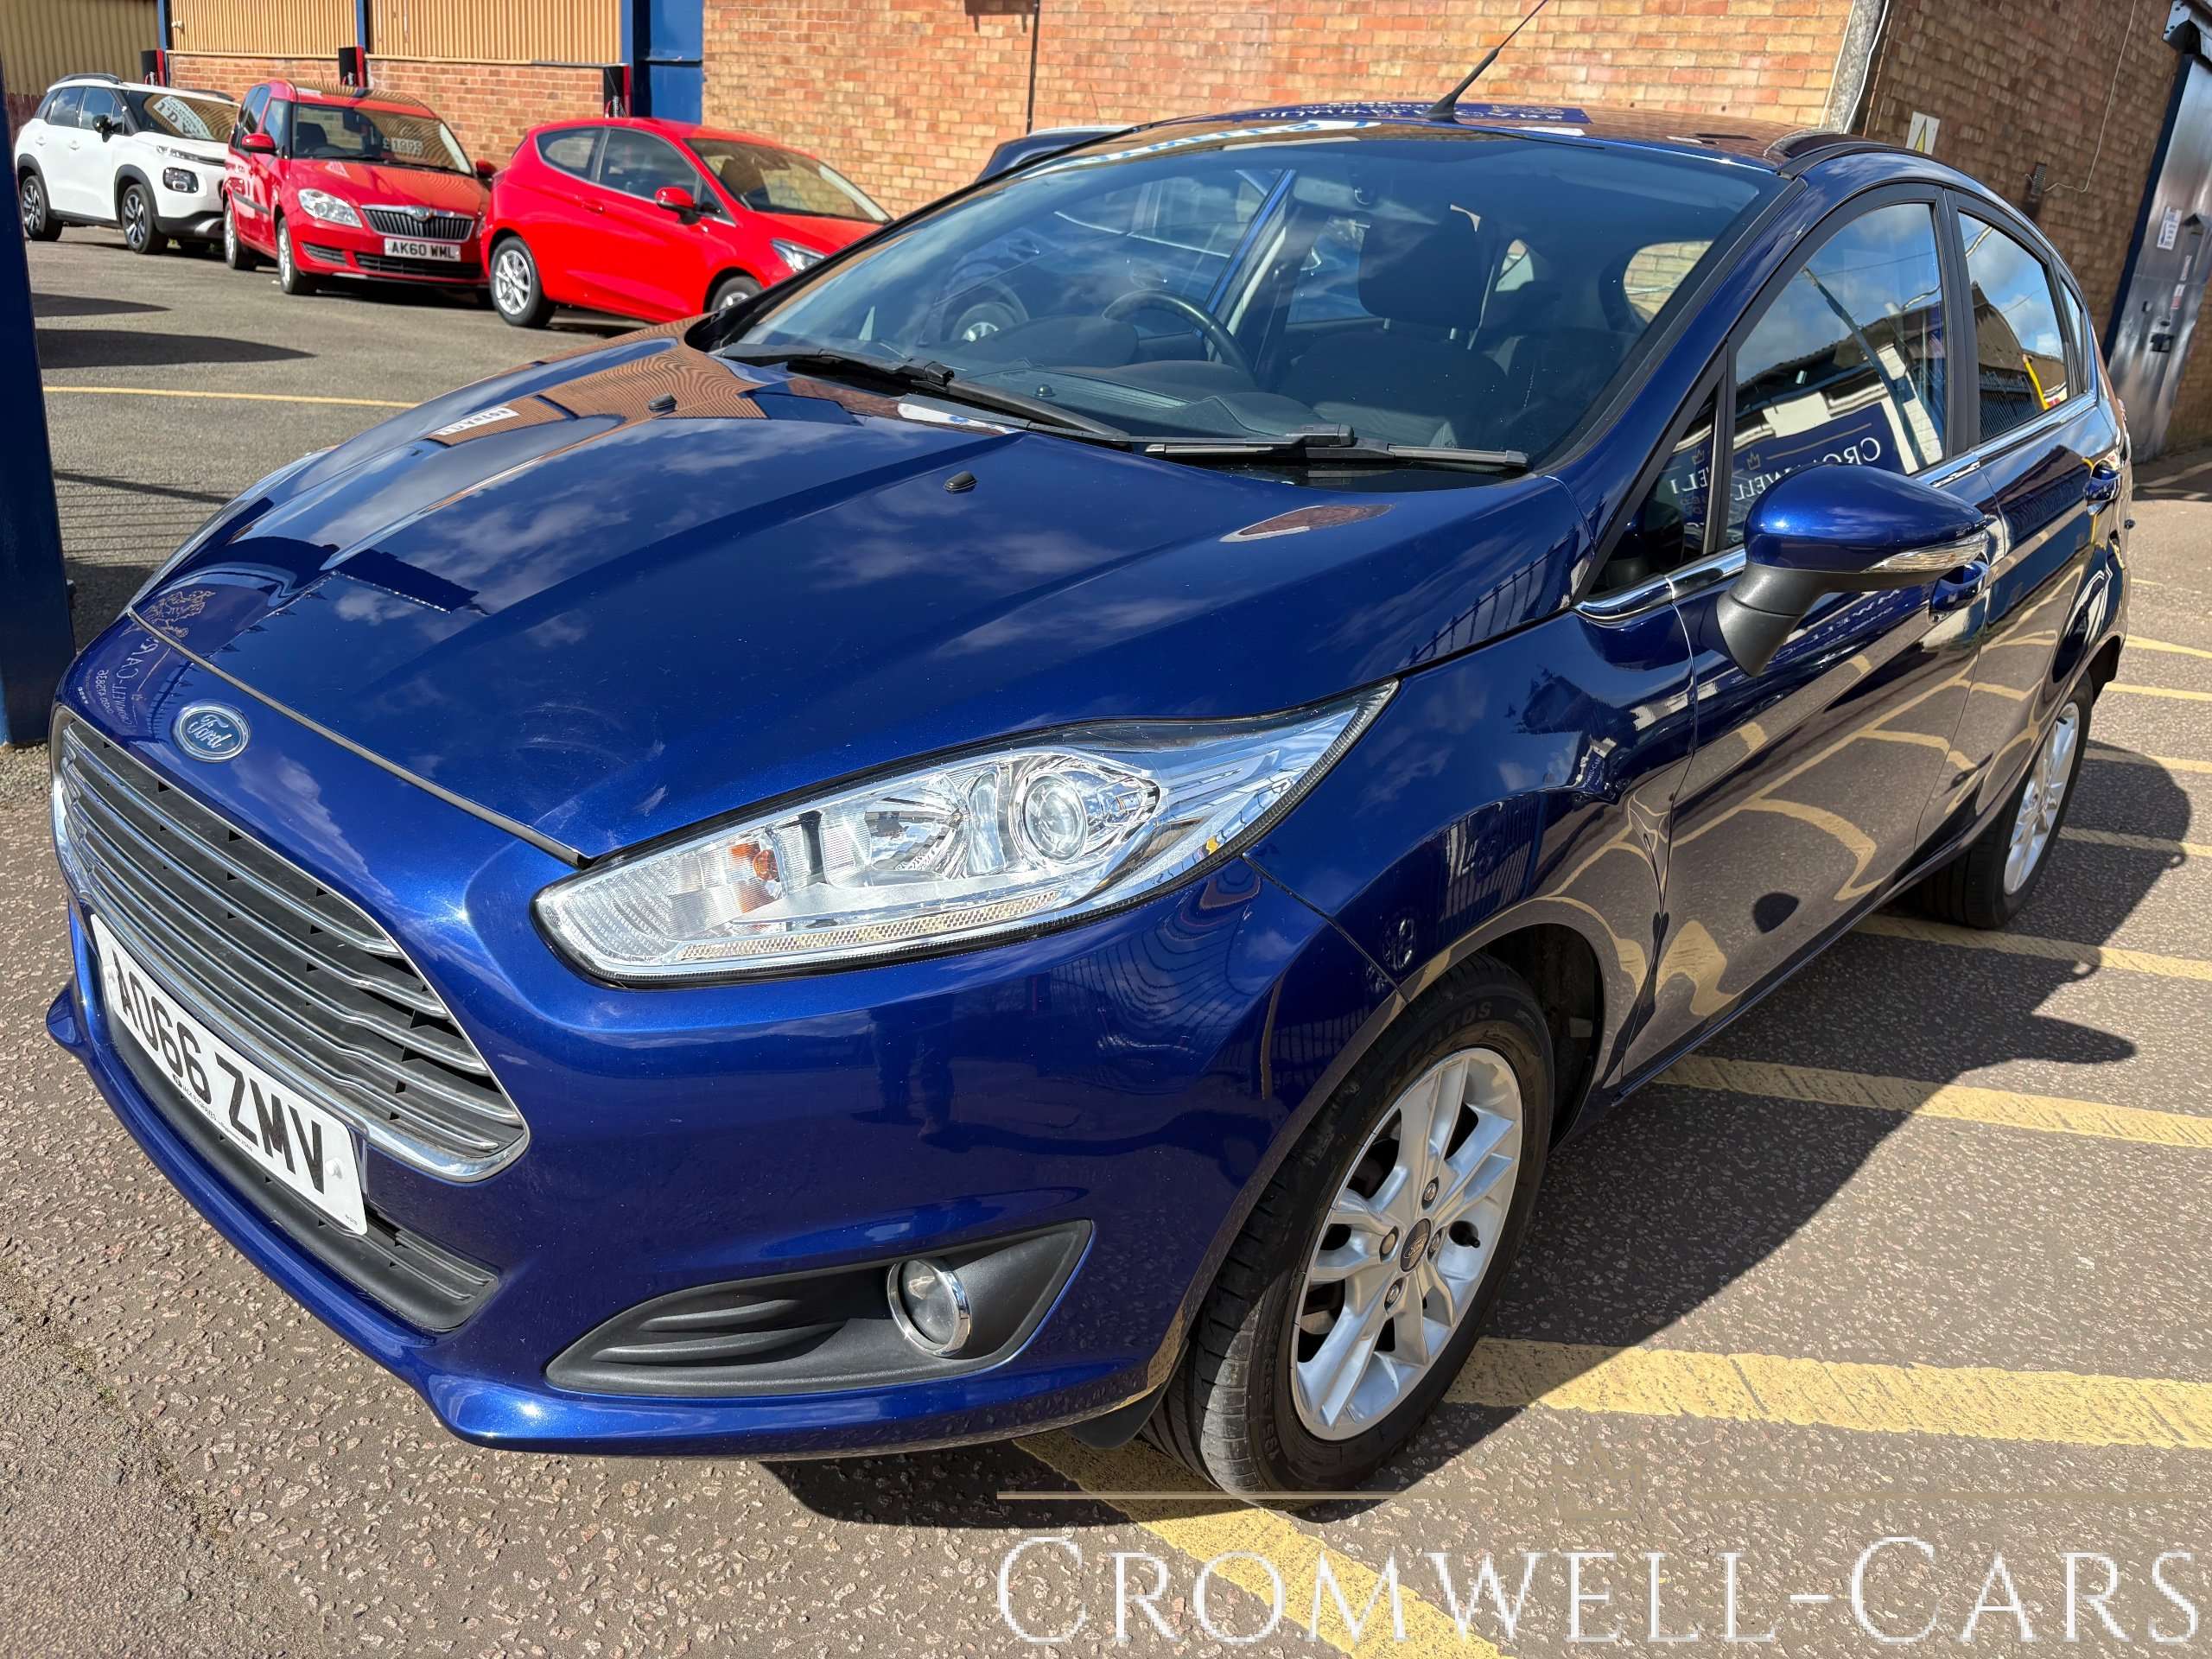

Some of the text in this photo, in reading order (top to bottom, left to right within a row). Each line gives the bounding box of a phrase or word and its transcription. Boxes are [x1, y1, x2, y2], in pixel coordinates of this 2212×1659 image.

[391, 242, 455, 259] AK60 WML
[188, 714, 233, 749] Ford
[214, 1052, 325, 1195] ZMV
